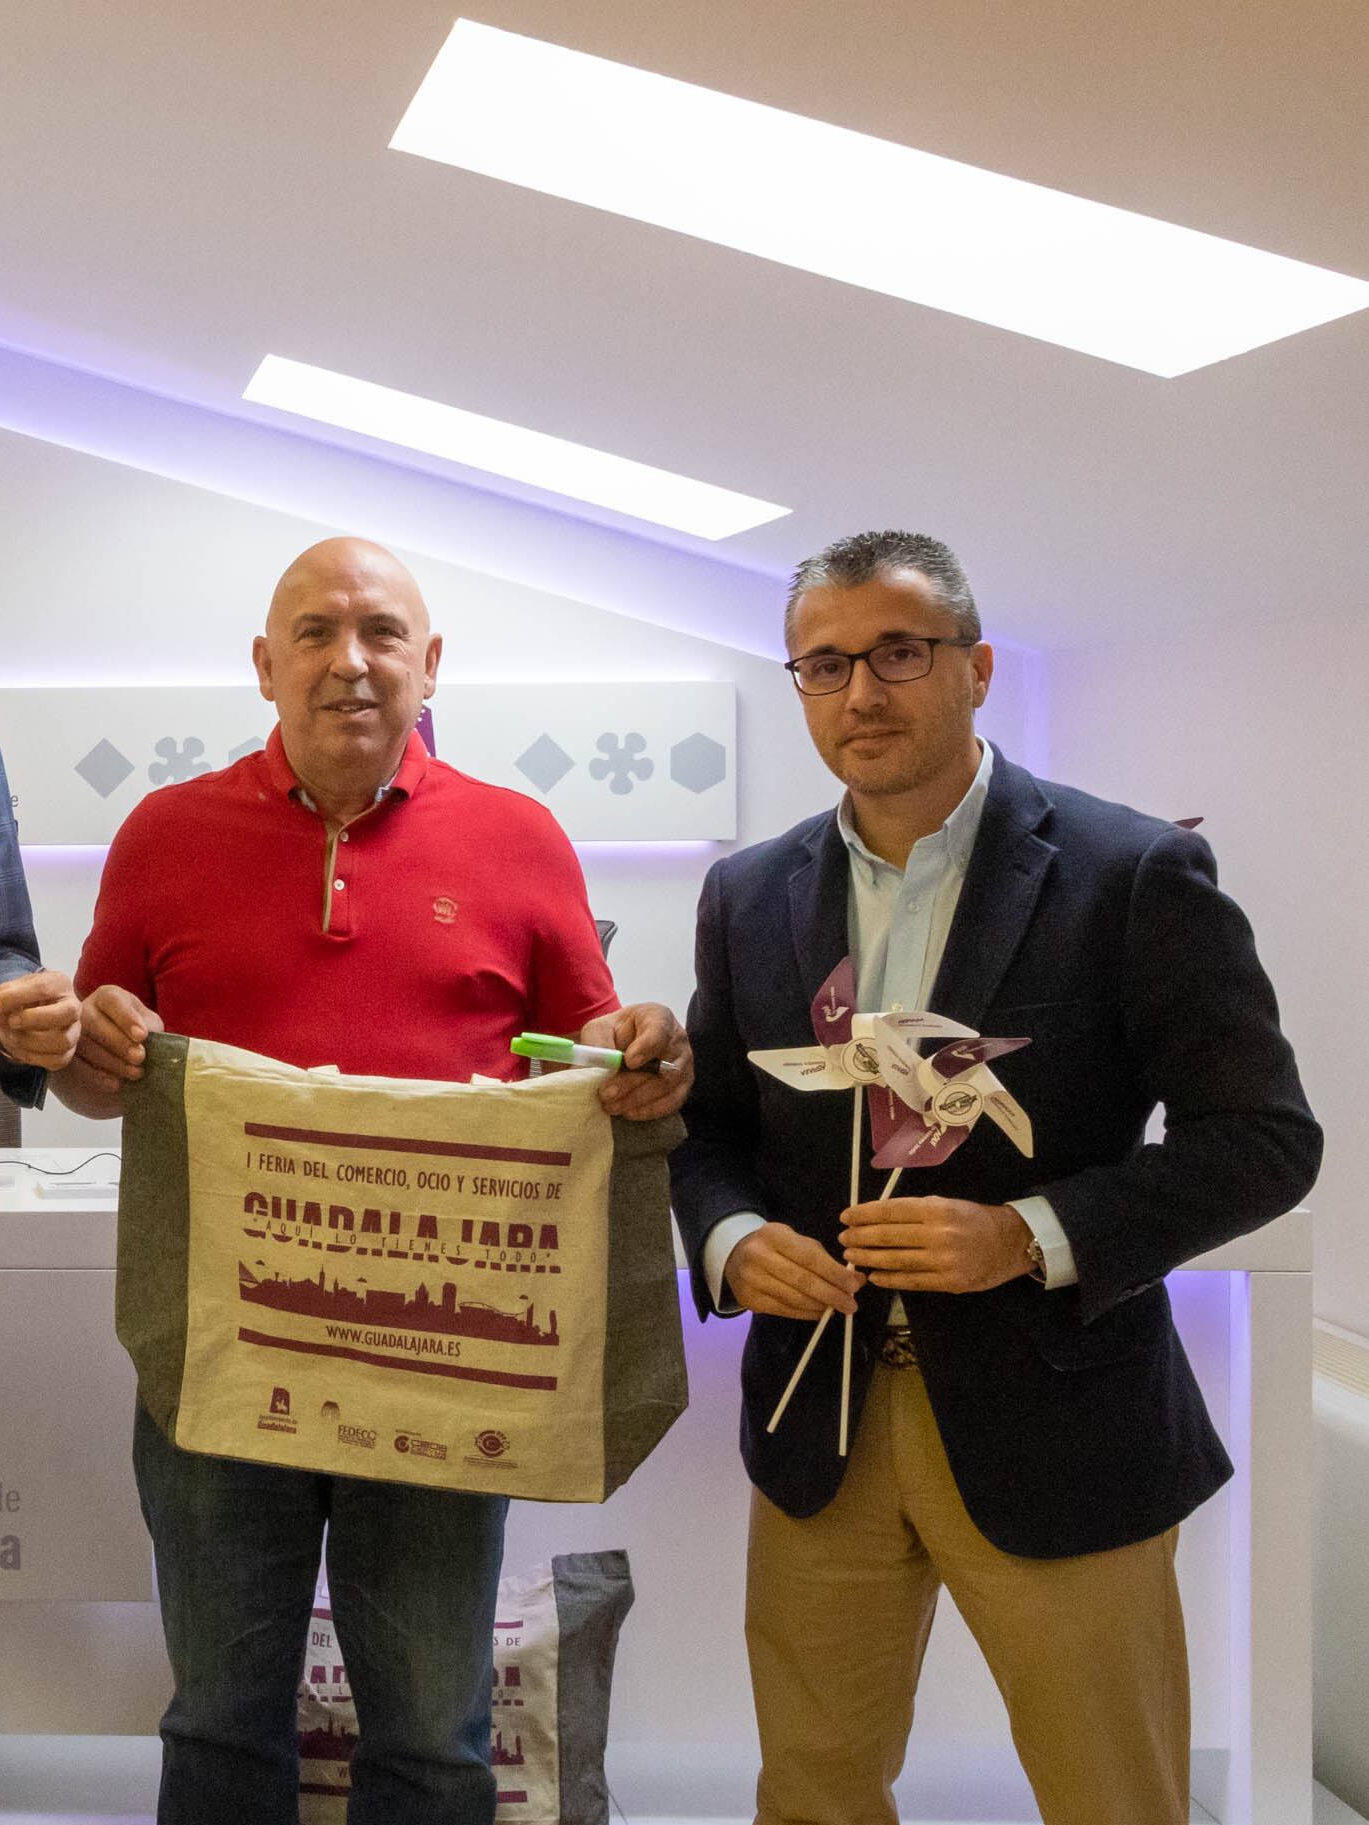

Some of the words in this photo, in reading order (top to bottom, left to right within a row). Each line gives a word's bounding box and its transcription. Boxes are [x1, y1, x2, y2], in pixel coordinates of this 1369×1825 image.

[246, 1152, 251, 1168] I
[259, 1153, 296, 1174] FERIA
[303, 1161, 329, 1179] DEL
[336, 1164, 410, 1190] COMERCIO,
[417, 1171, 451, 1191] OCIO
[457, 1175, 465, 1193] Y
[472, 1177, 540, 1199] SERVICIOS
[546, 1183, 563, 1199] DE
[335, 1233, 357, 1244] LO
[382, 1237, 461, 1255] TIENES
[326, 1325, 461, 1357] WWW.GUADALAJARA.ES
[338, 1424, 377, 1441] FEDECO
[312, 1632, 332, 1648] DEL
